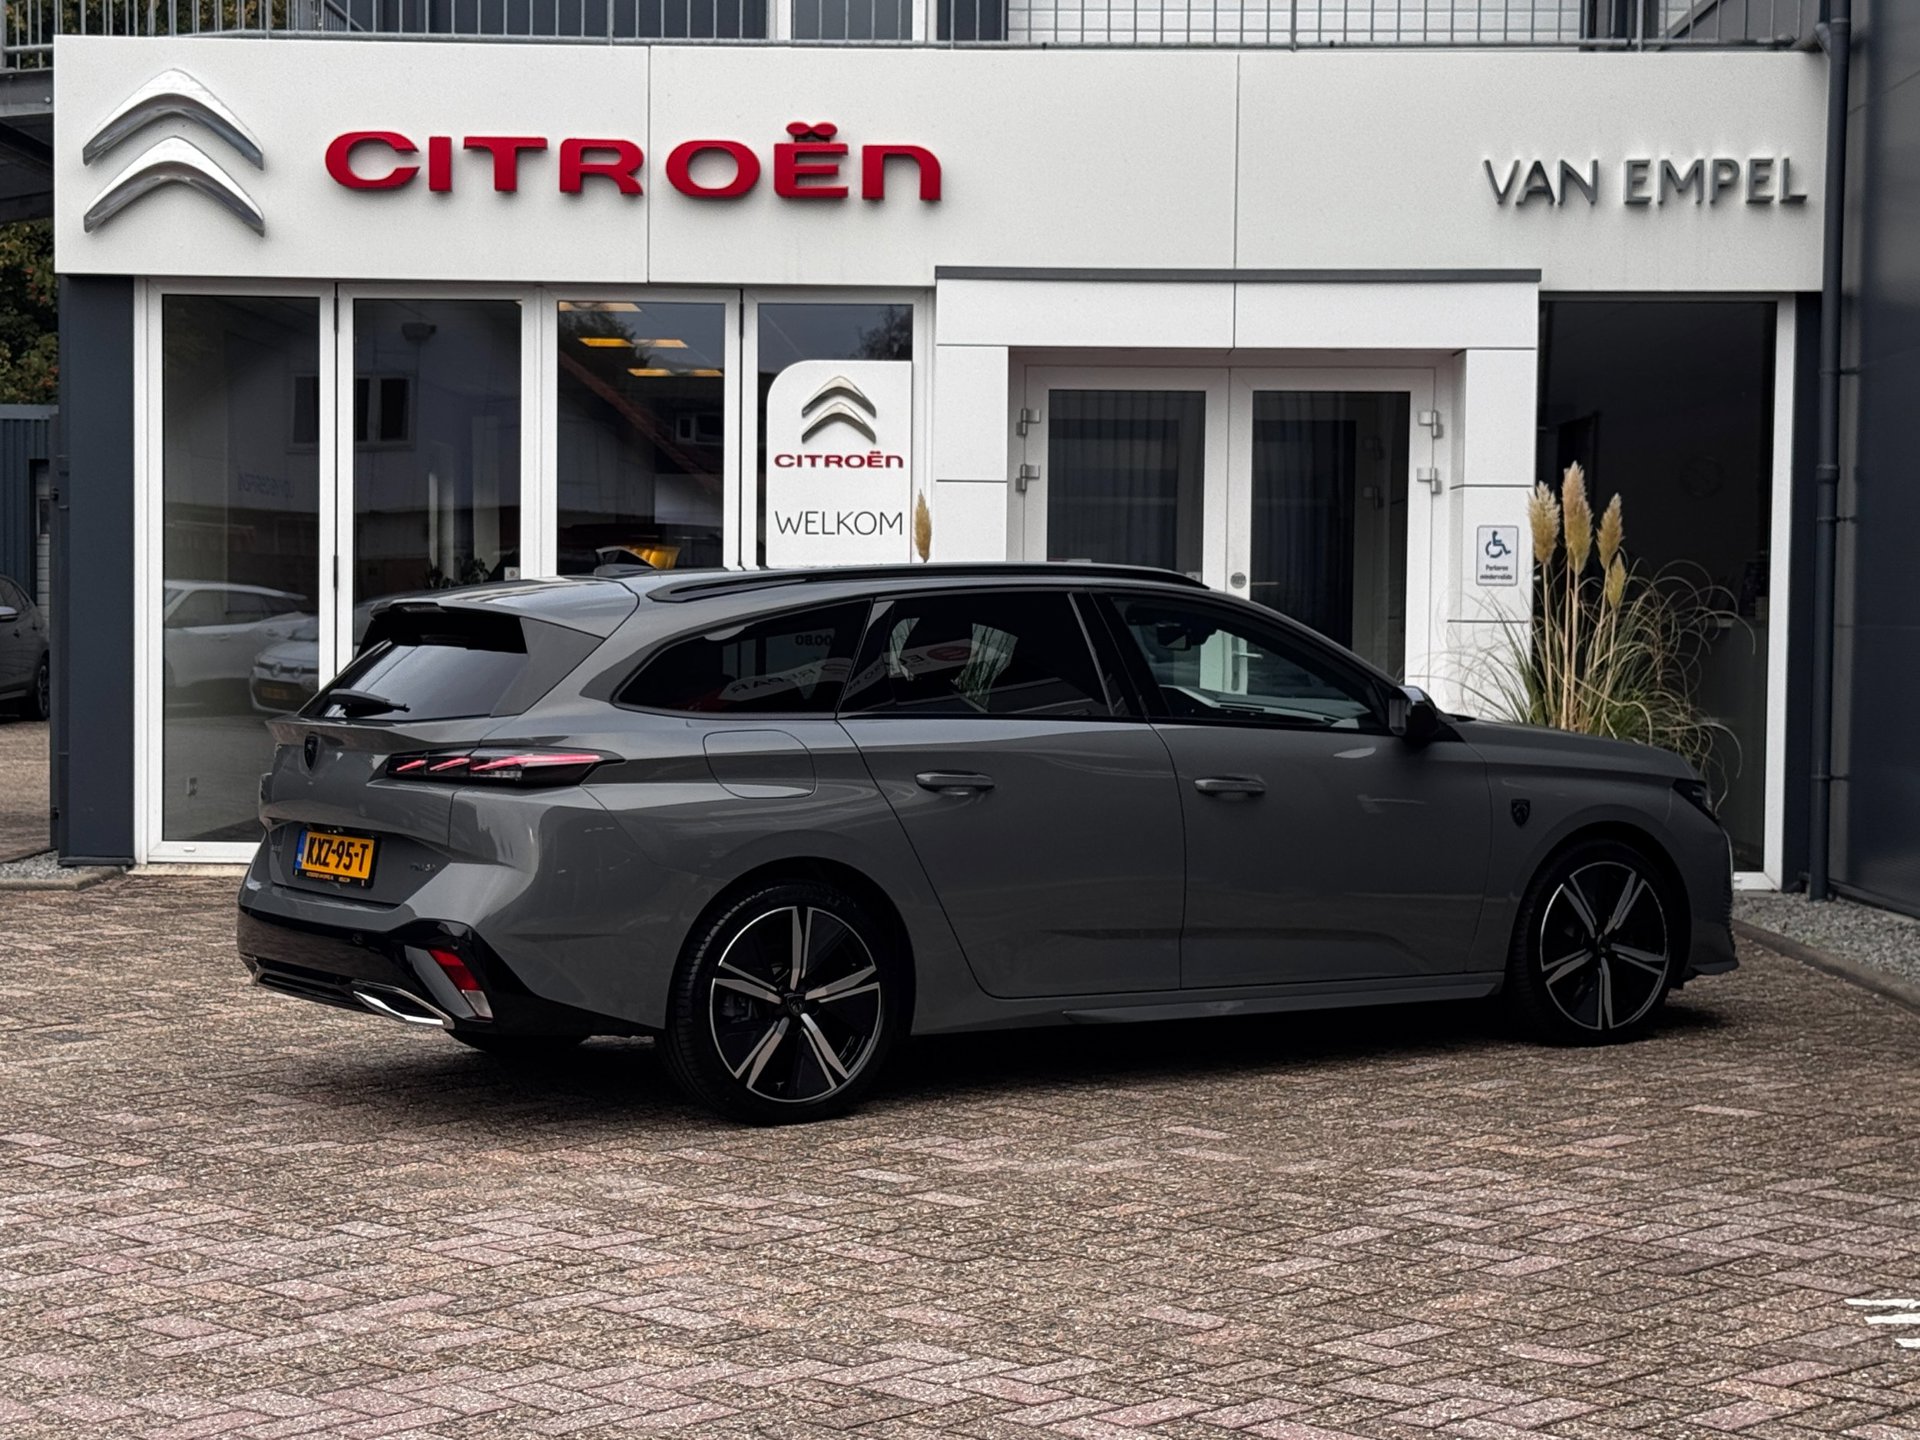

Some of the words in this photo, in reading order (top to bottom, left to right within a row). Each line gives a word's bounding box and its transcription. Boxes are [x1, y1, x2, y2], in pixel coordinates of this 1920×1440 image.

[1483, 159, 1599, 205] VAN
[1624, 158, 1807, 204] EMPEL
[775, 511, 903, 535] WELKOM
[306, 837, 370, 872] KXZ-95-T
